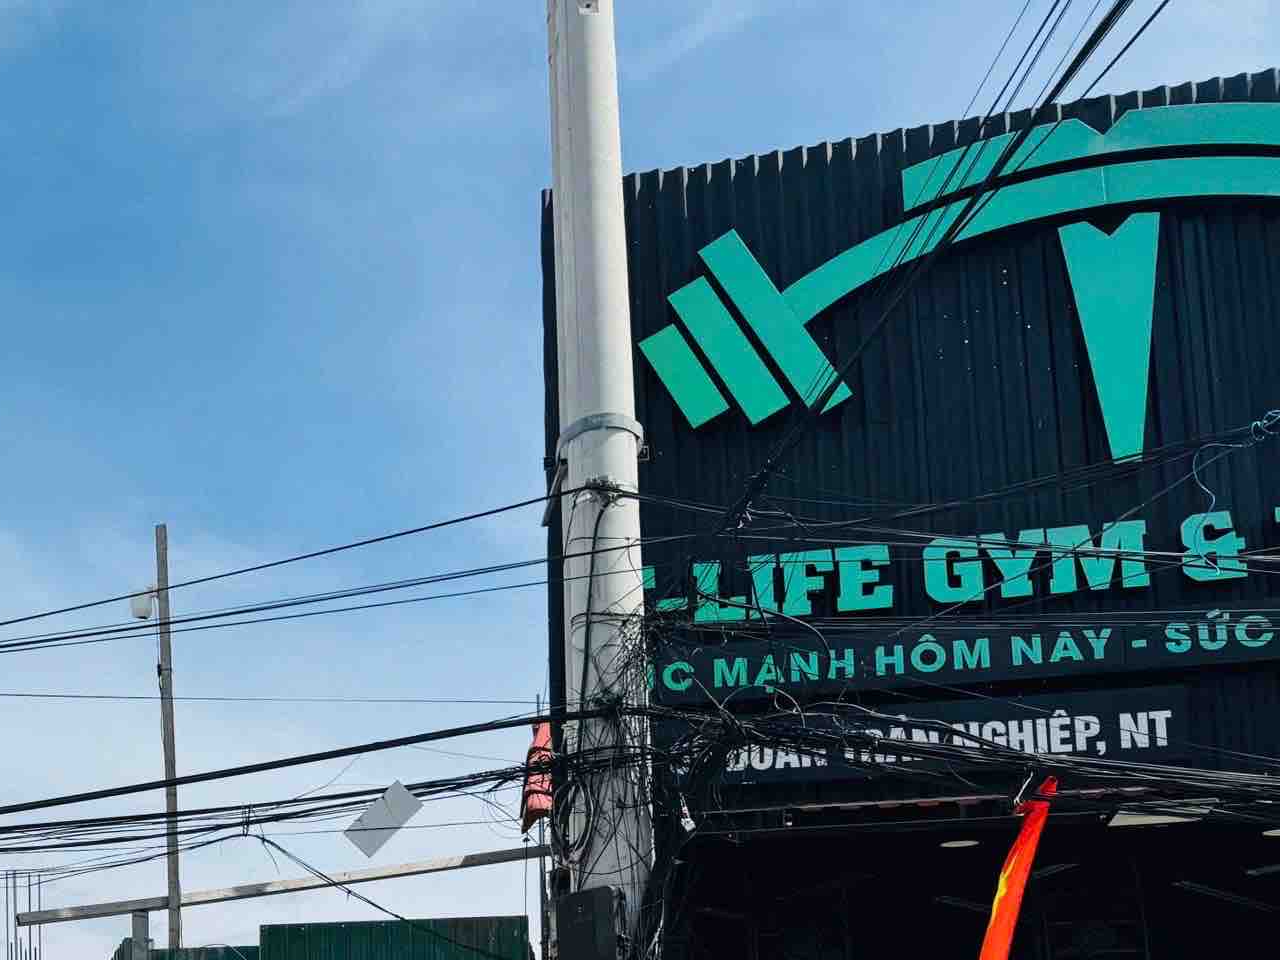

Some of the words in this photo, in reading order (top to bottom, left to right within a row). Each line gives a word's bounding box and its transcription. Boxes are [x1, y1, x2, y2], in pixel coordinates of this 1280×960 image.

[922, 520, 1150, 603] GYM
[1180, 511, 1248, 581] &
[713, 649, 854, 692] MẠNH
[875, 634, 990, 676] HÔM
[1011, 628, 1112, 666] NAY
[1164, 609, 1274, 652] SỨC
[1119, 710, 1171, 749] NT
